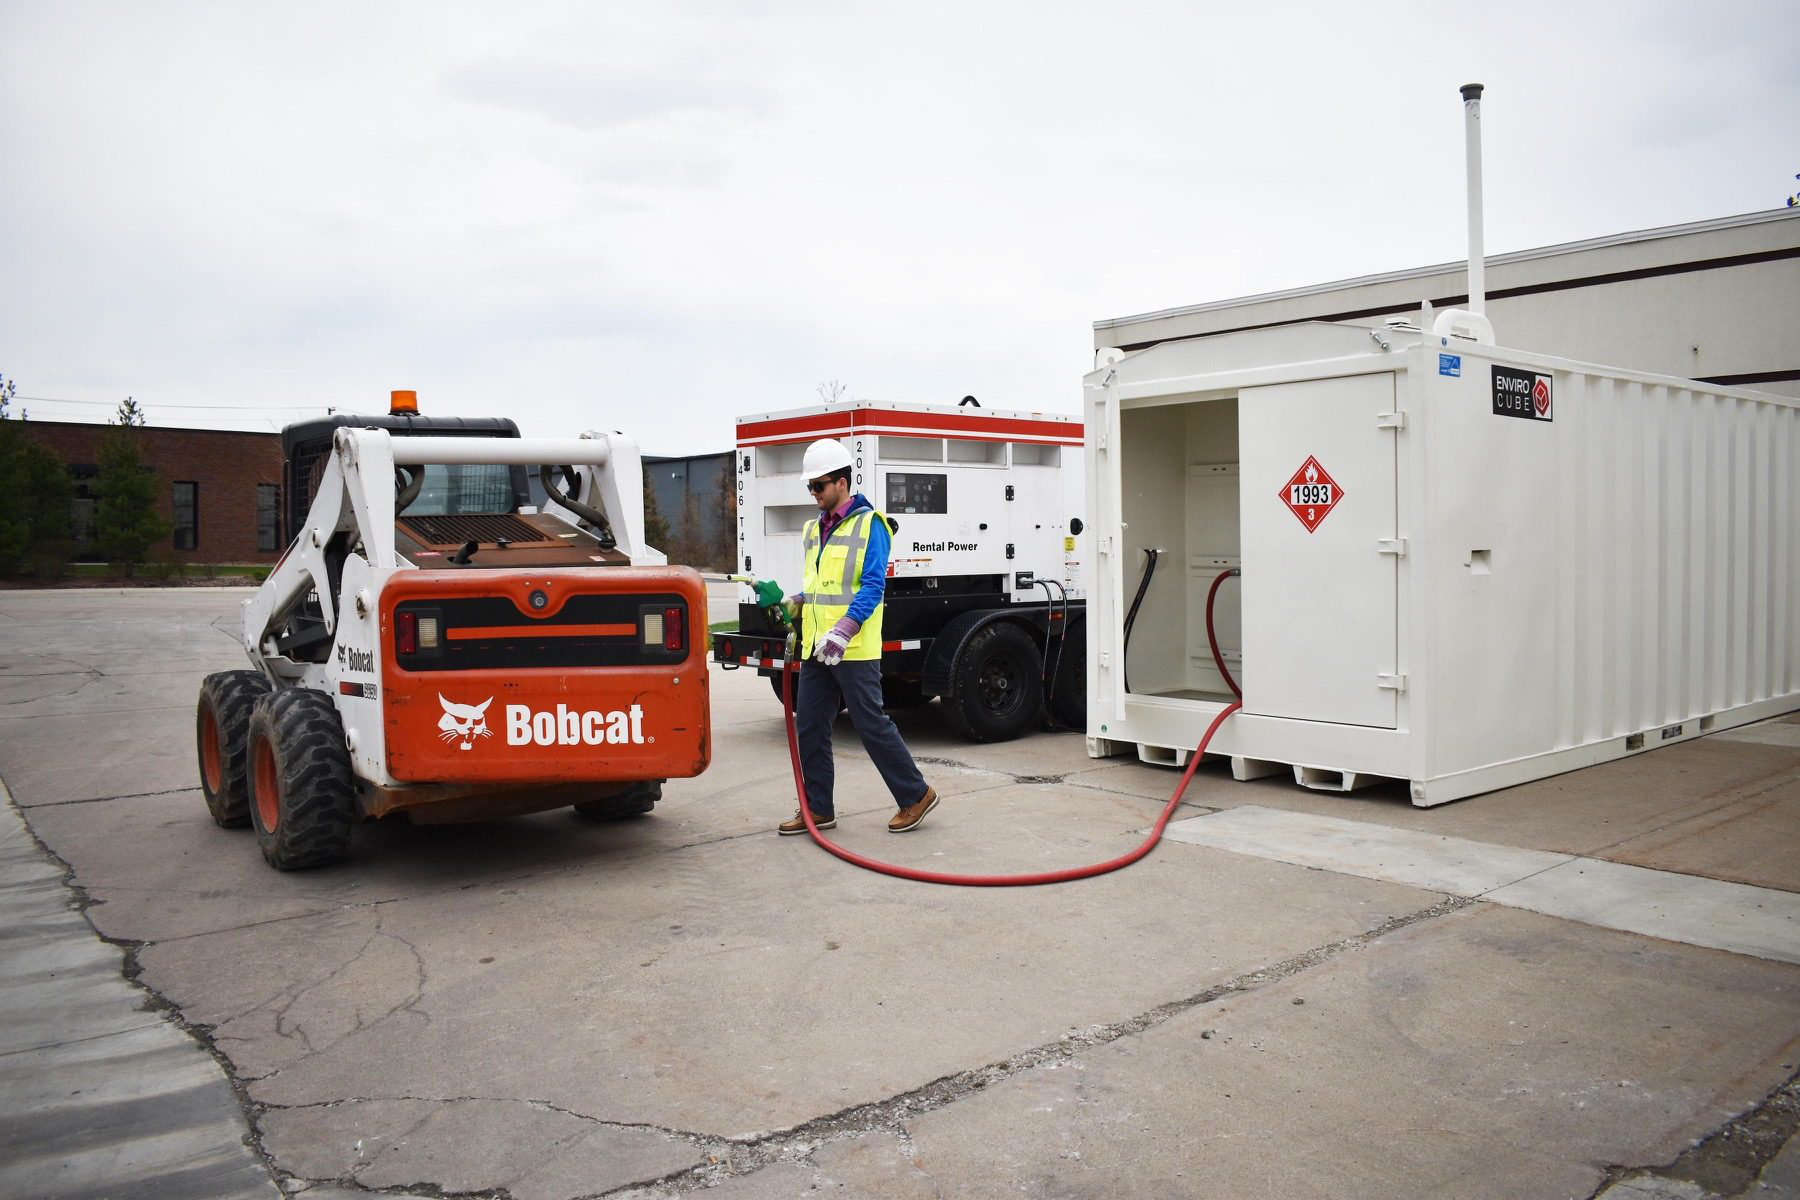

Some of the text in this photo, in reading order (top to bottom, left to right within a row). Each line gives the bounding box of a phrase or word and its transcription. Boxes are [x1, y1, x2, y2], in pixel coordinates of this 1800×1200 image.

[1496, 375, 1530, 394] ENVIRO
[1497, 393, 1530, 411] CUBE
[1294, 485, 1329, 504] 1993
[1308, 508, 1315, 521] 3
[912, 541, 978, 552] Rental Power
[348, 647, 374, 673] Bobcat
[506, 703, 645, 746] Bobcat
